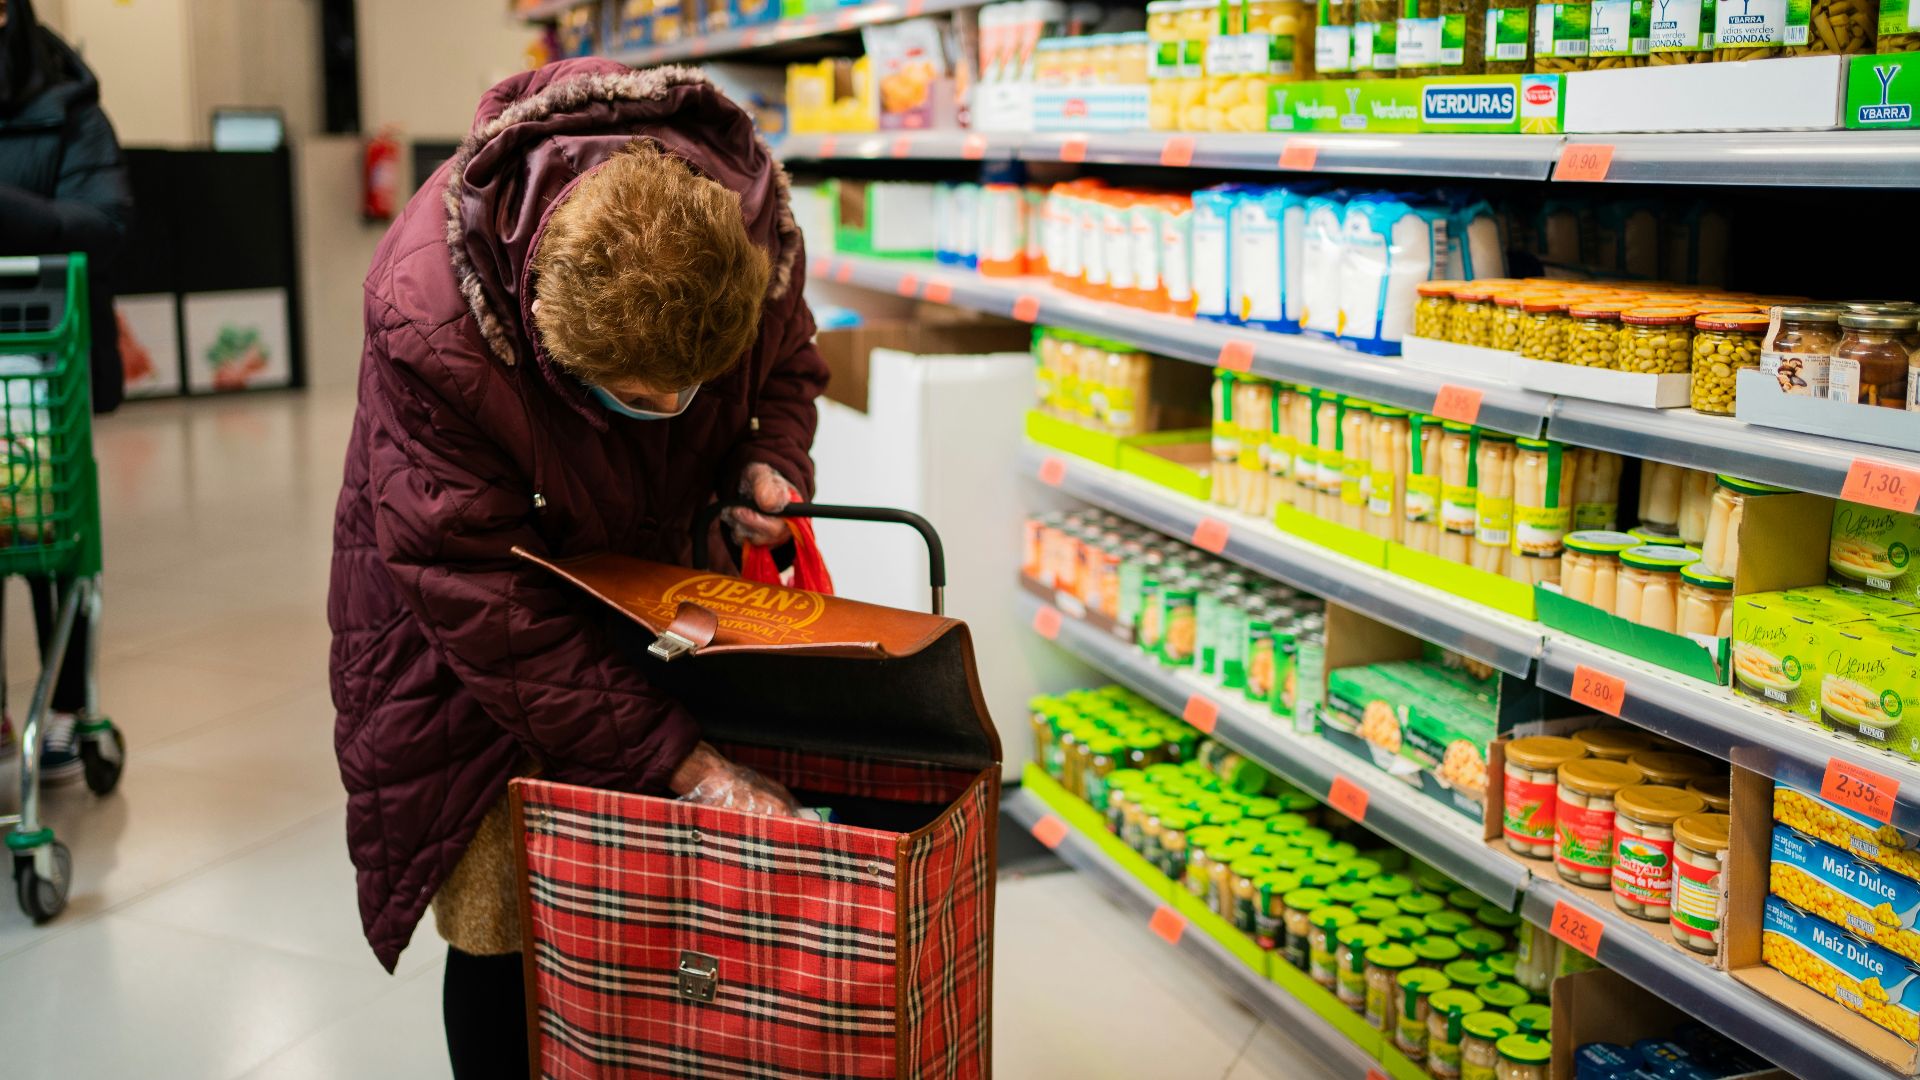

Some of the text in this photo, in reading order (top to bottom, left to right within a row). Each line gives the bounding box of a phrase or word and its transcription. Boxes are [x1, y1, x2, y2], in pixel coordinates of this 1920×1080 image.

[1730, 16, 1762, 24] YBARRA
[1745, 24, 1775, 34] verdes
[1722, 34, 1771, 43] REDONDAS
[1371, 98, 1418, 119] Verduras
[1427, 93, 1513, 115] VERDURAS
[1862, 107, 1907, 119] YBARRA
[698, 579, 803, 612] JEAN
[740, 607, 799, 625] TROLLEY
[1836, 773, 1881, 806] 2,35€
[1822, 855, 1896, 901] Maíz Dulce
[1812, 927, 1884, 976] Maíz Dulce
